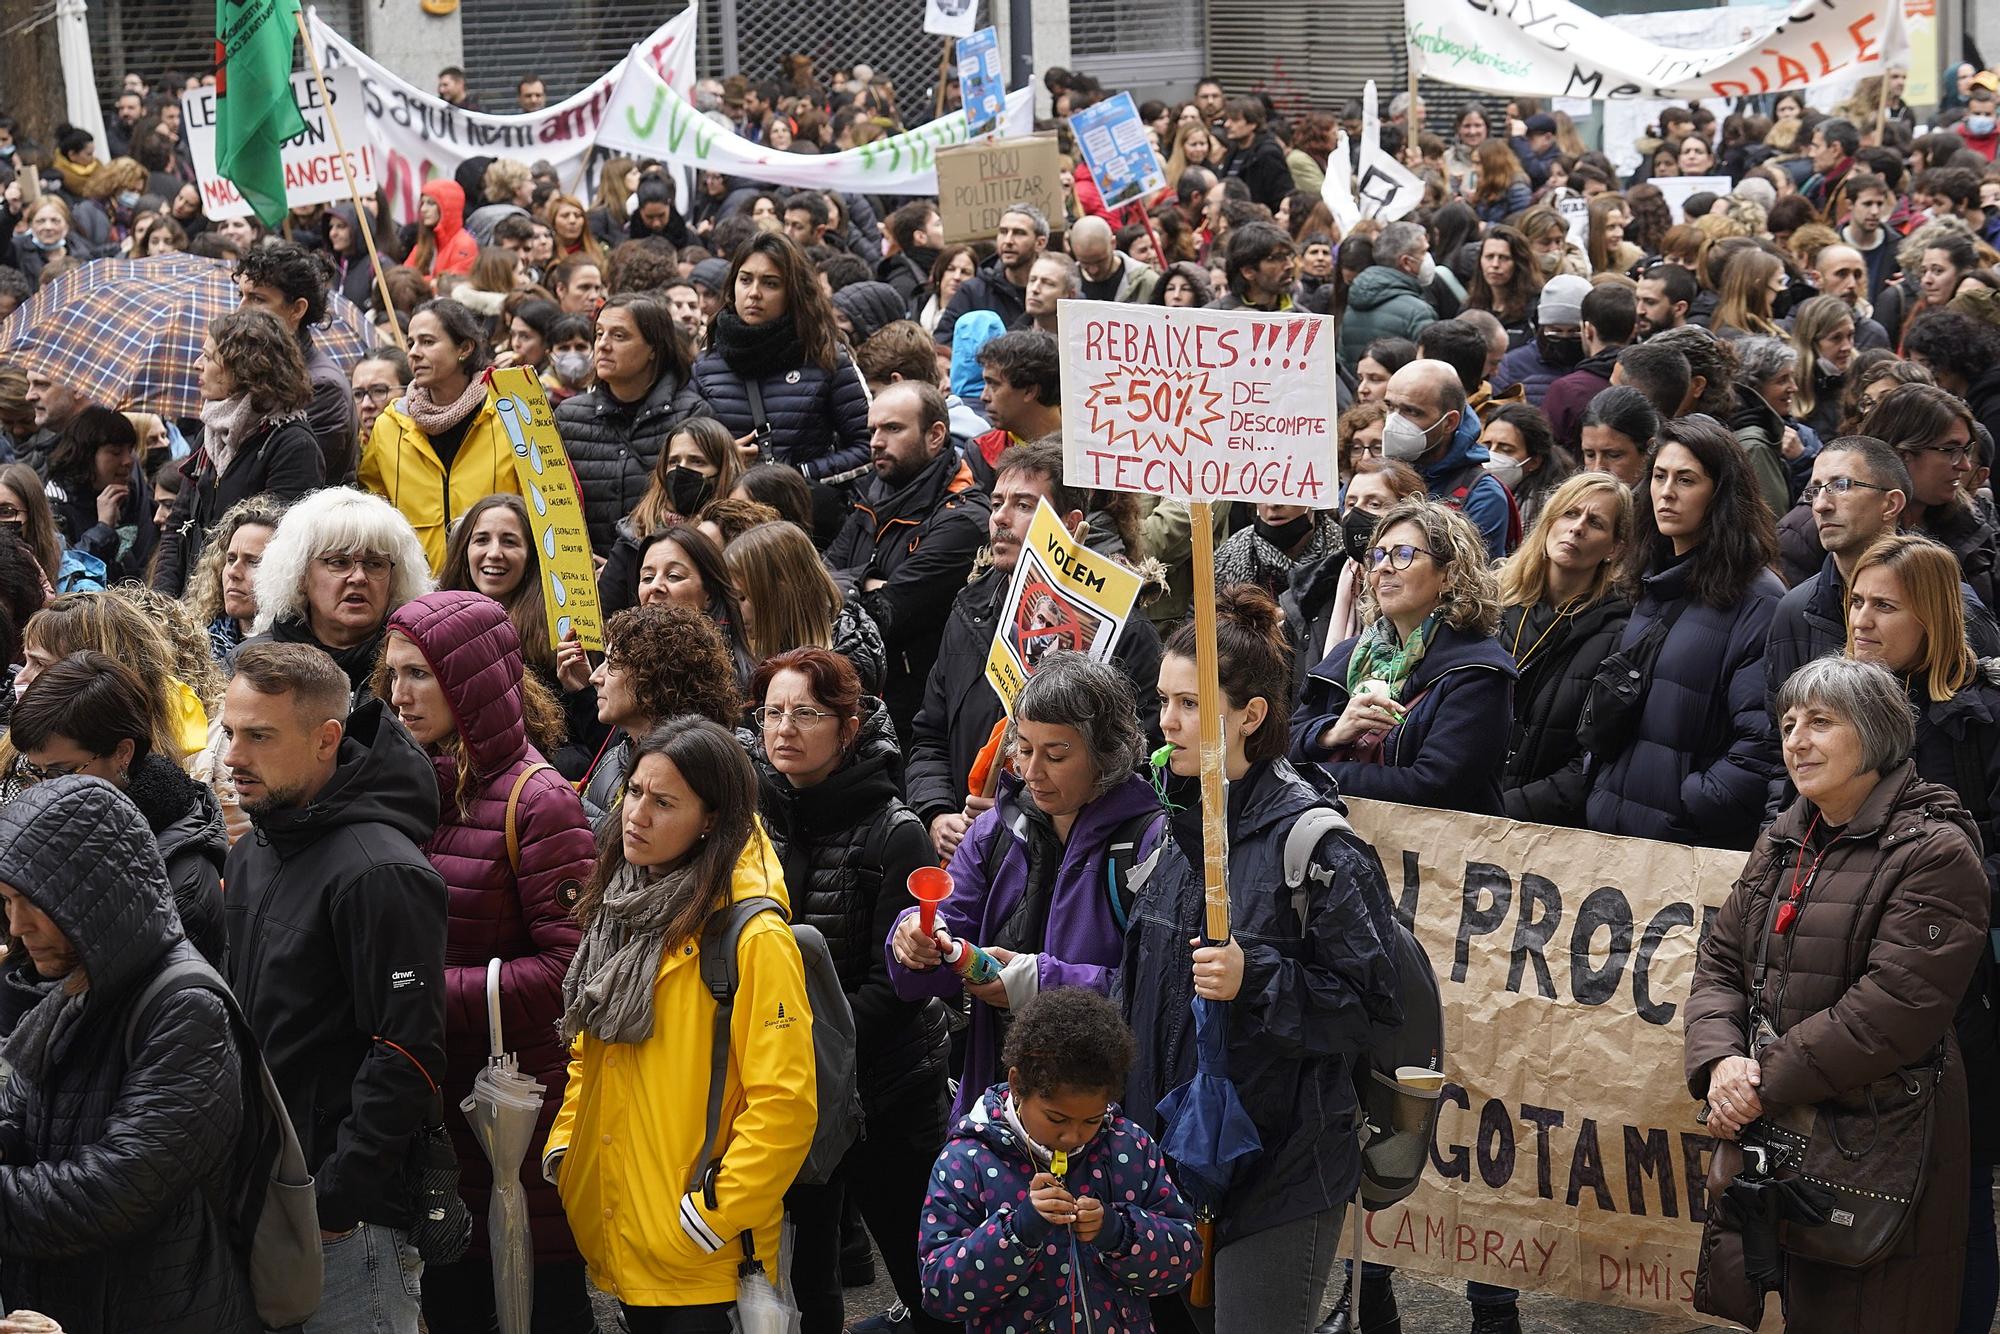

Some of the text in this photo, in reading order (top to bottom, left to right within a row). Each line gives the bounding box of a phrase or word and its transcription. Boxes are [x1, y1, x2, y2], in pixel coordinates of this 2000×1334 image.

[978, 149, 1021, 180] PROU
[955, 176, 1044, 207] POLITITZAR
[1104, 379, 1194, 428] -50%
[1232, 382, 1272, 406] DE
[1229, 410, 1327, 436] DESCOMPTE
[1227, 436, 1275, 451] EN...
[1047, 532, 1106, 594] VOLEM
[1429, 1082, 1721, 1224] GOTAME
[1364, 1209, 1697, 1303] CAMBRAY DIMIS
